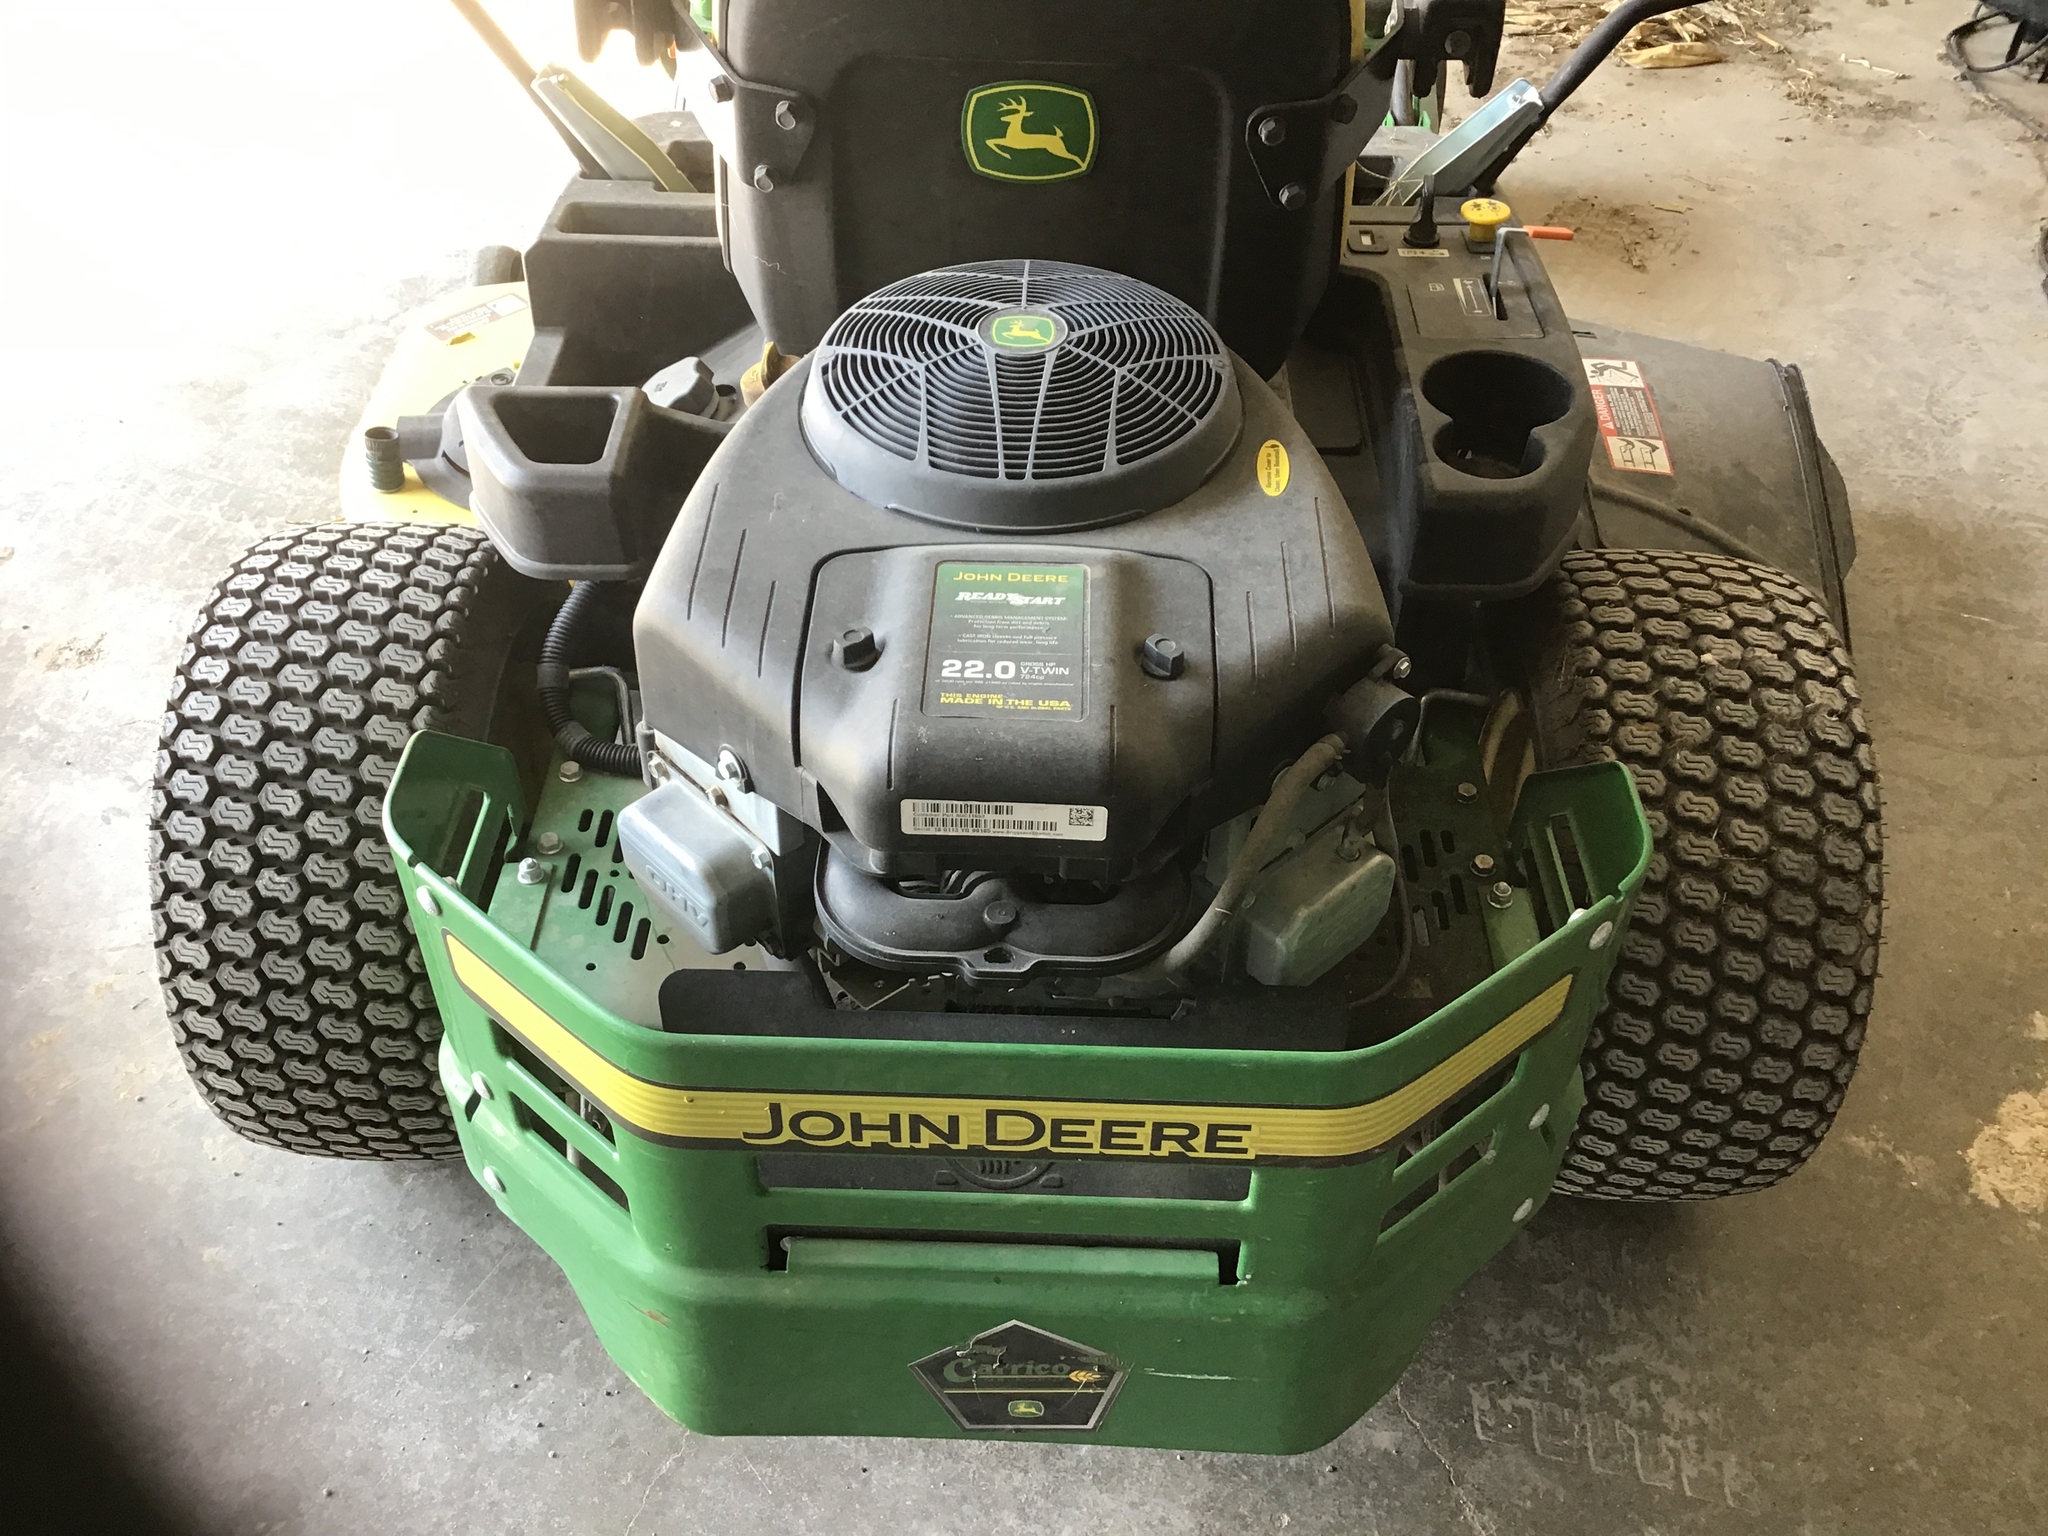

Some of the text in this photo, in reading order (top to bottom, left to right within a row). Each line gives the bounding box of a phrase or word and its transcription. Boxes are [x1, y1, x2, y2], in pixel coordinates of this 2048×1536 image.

[1591, 389, 1611, 420] DANGER
[953, 571, 1069, 583] JOHN DEERE
[941, 659, 1016, 679] 22.0
[1020, 666, 1070, 675] V-TWIN
[742, 1102, 1253, 1155] JOHN DEERE
[943, 1358, 1071, 1382] Carrico
